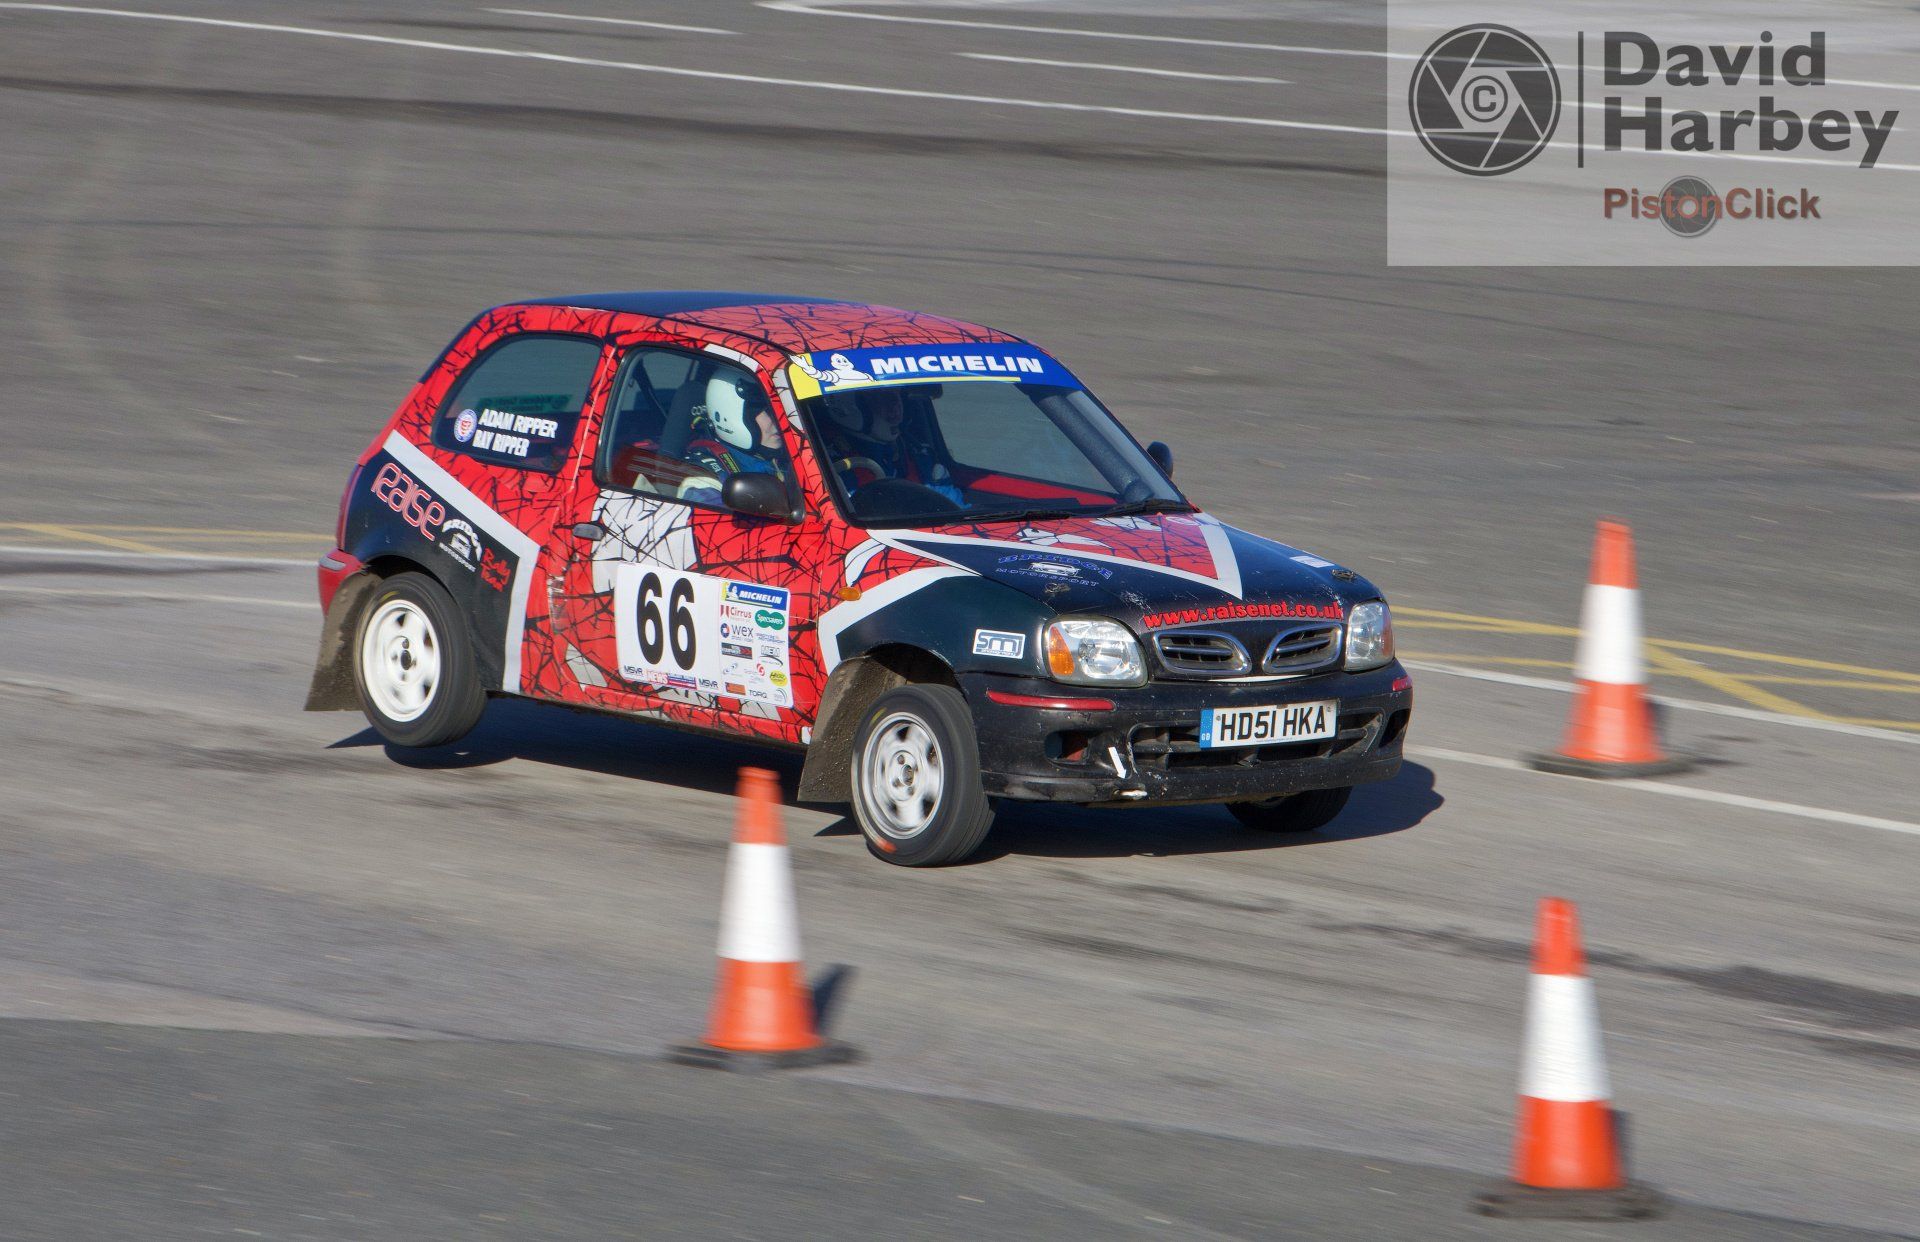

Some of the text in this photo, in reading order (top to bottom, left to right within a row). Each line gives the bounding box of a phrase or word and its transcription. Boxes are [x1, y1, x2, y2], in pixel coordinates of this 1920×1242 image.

[870, 355, 1044, 375] MICHELIN
[478, 408, 559, 439] ADAM RIPPER
[492, 433, 530, 457] RIPPER
[995, 567, 1099, 587] MOTORSPORT
[998, 554, 1113, 580] BRIDGE
[739, 590, 783, 604] MICHELIN
[637, 571, 696, 671] 66
[730, 606, 752, 619] Cirrus
[1144, 602, 1344, 628] www.raisenet.co.uk
[731, 624, 754, 638] wex
[1220, 705, 1327, 742] HD51 HKA
